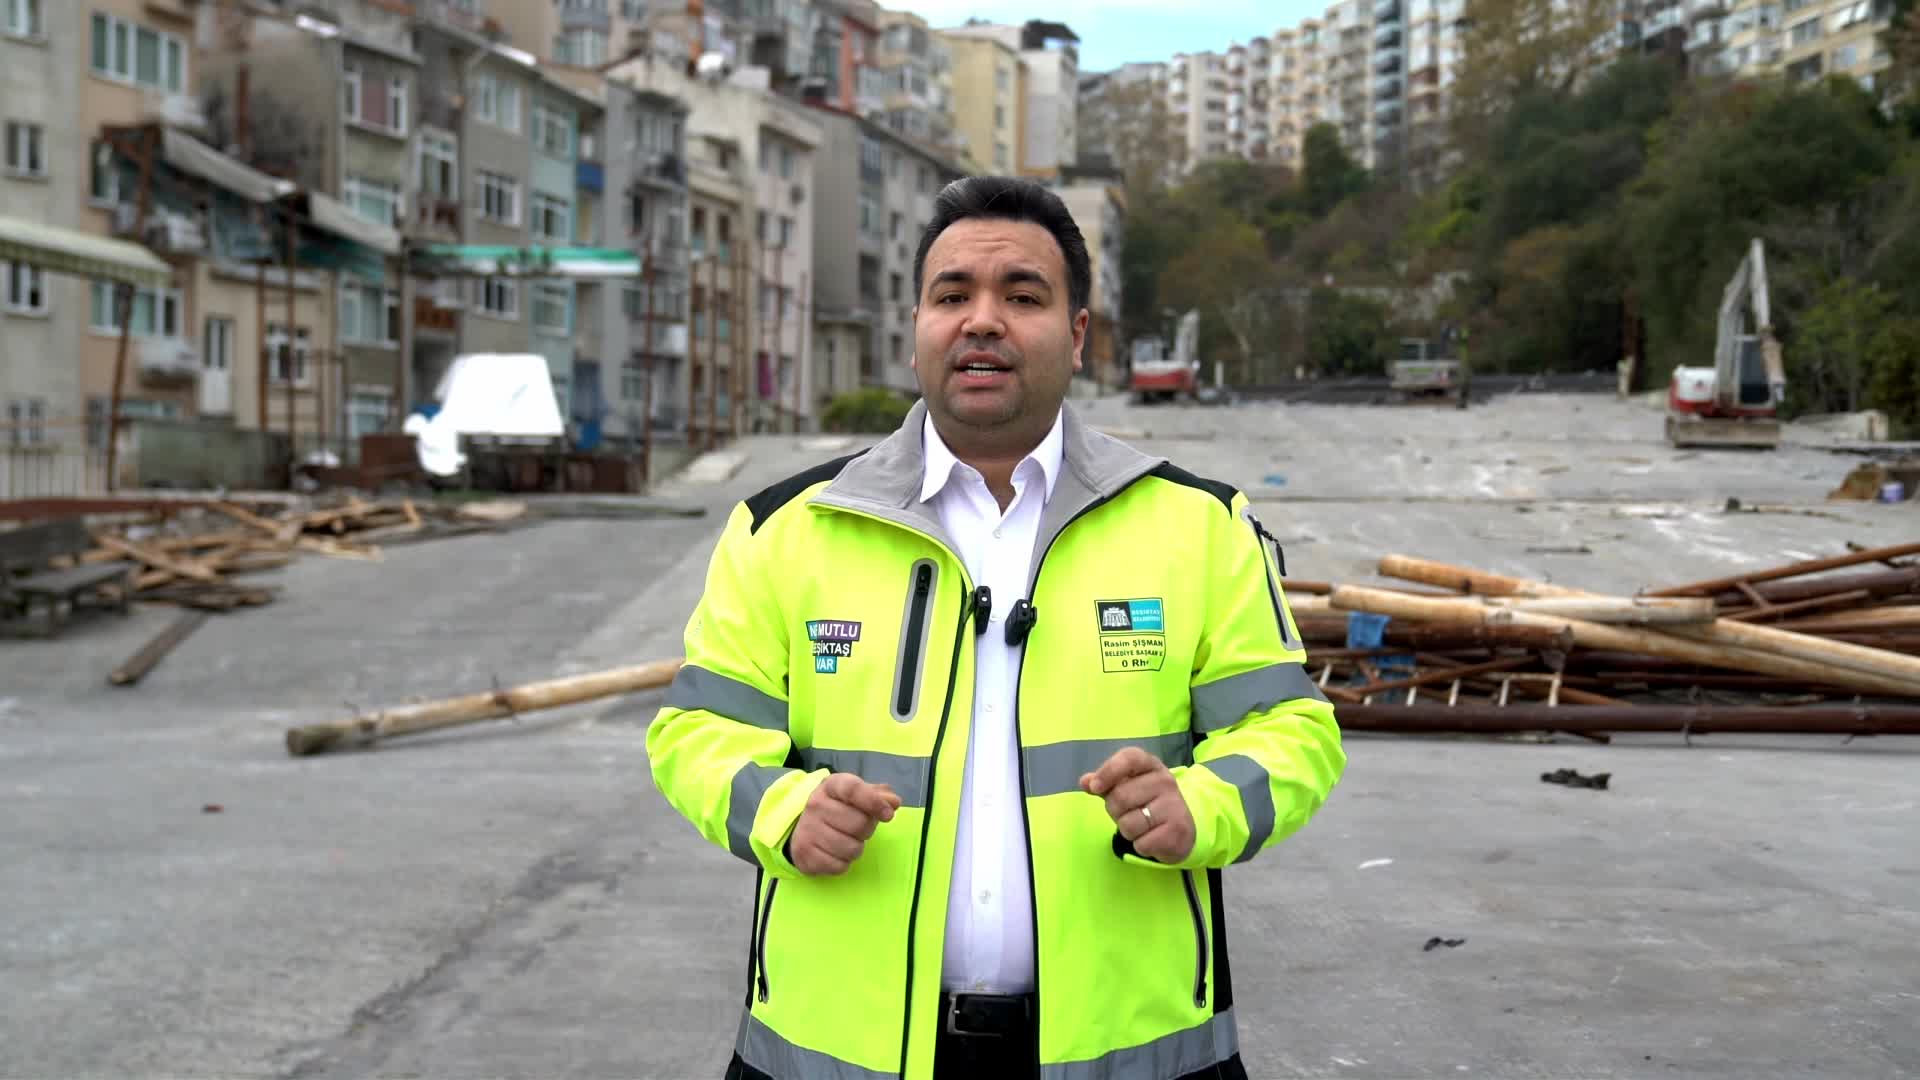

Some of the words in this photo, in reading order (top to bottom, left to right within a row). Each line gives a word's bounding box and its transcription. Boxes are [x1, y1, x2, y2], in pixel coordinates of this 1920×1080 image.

[818, 623, 858, 637] MUTLU
[812, 640, 850, 656] EŞİKTAŞ
[816, 658, 834, 670] VAR
